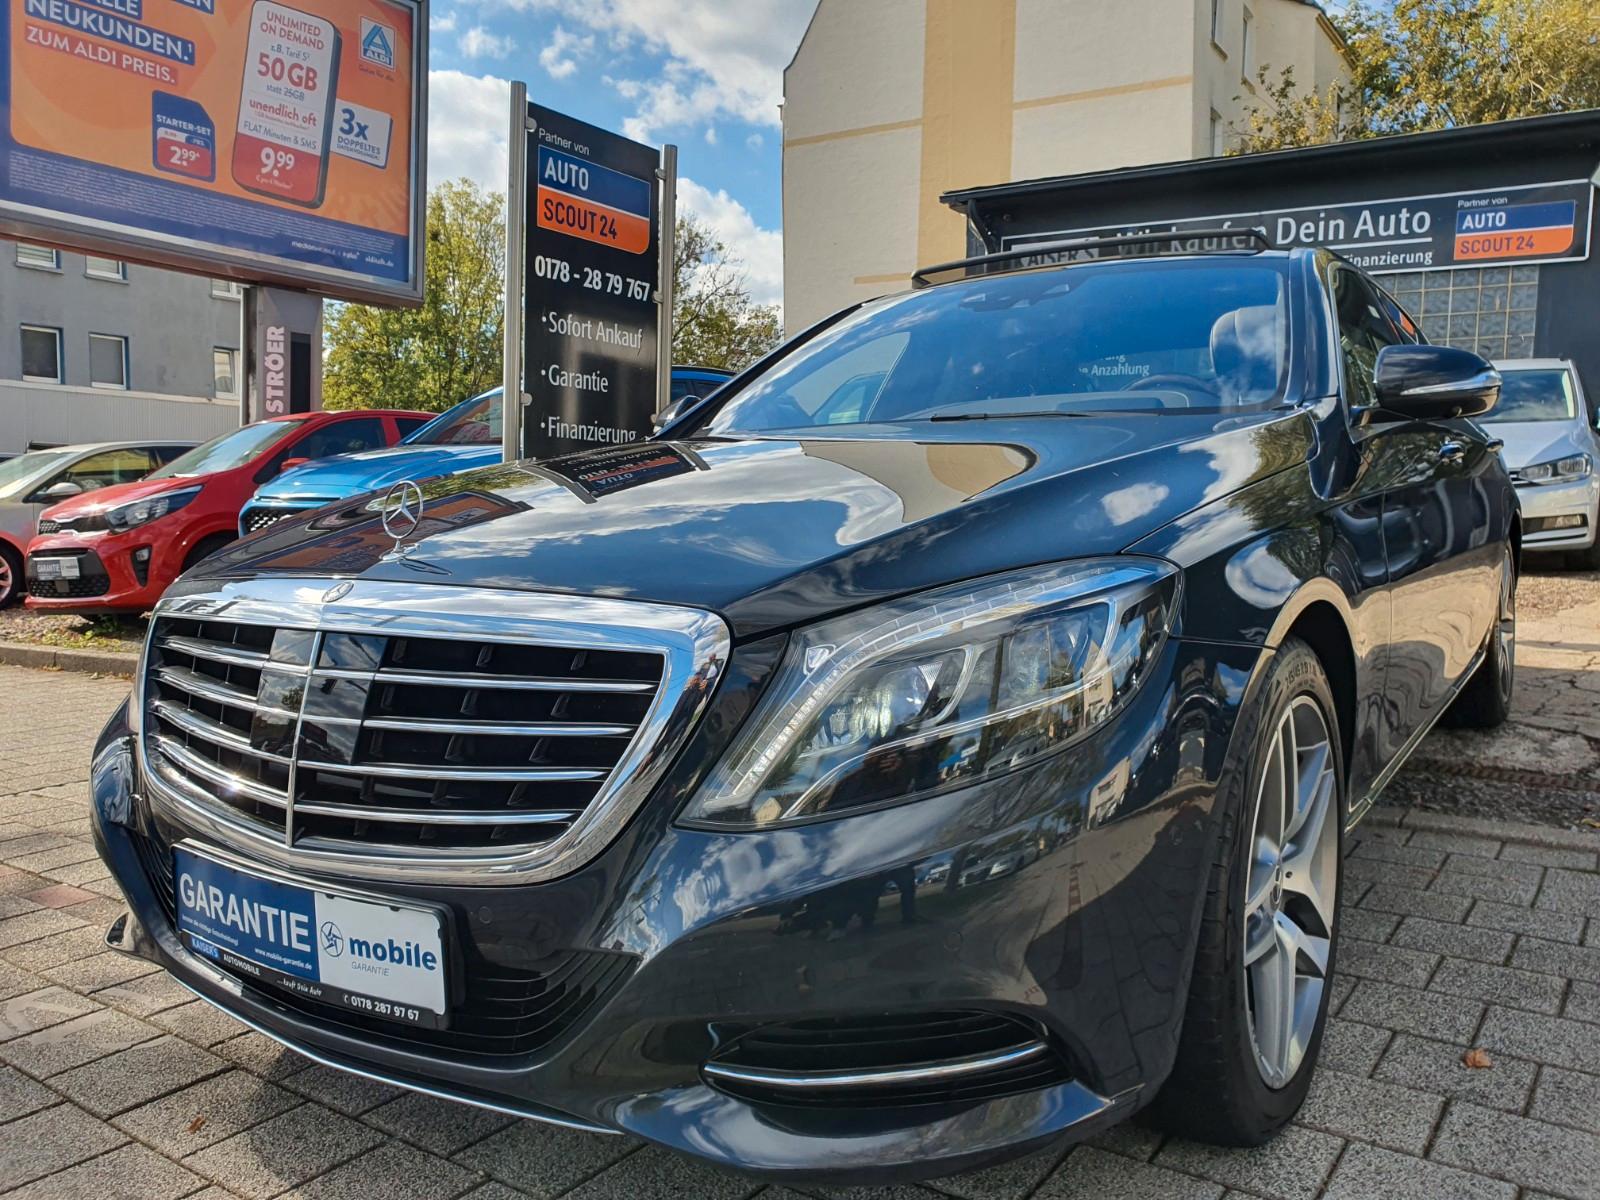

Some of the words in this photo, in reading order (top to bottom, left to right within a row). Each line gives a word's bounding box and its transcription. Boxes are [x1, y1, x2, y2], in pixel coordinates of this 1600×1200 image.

[260, 22, 277, 35] ON
[279, 27, 325, 50] DEMAND
[266, 10, 321, 36] UNLIMITED
[27, 25, 70, 52] ZUM
[74, 40, 116, 65] ALDI
[122, 54, 176, 83] PREIS.
[156, 114, 211, 136] STARTER-SET
[249, 99, 299, 121] unendlich
[302, 112, 317, 127] oft
[339, 107, 369, 141] 3x
[243, 120, 262, 133] FLAT
[300, 138, 317, 150] SMS
[337, 135, 381, 155] DOPPELTES
[538, 128, 572, 149] Partner
[574, 142, 590, 156] von
[544, 156, 589, 191] AUTO
[1457, 199, 1490, 208] Partner
[1491, 197, 1508, 206] von
[1276, 212, 1345, 245] Dein
[1353, 207, 1431, 239] Auto
[1462, 211, 1506, 230] AUTO
[1343, 251, 1433, 268] inanzierung
[534, 255, 570, 283] 0178
[583, 267, 602, 290] 28
[605, 272, 623, 296] 79
[626, 278, 650, 302] 767
[548, 311, 592, 341] Sofort
[595, 320, 643, 349] Ankauf
[264, 326, 284, 413] STRÖER
[548, 364, 609, 393] Garantie
[1091, 363, 1150, 377] Anzahlung
[548, 415, 637, 444] Finanzierung
[180, 872, 311, 953] GARANTIE
[223, 953, 260, 976] AUTOMOBILE
[349, 937, 437, 971] mobile
[351, 961, 390, 976] GARANTIE
[351, 995, 372, 1010] 0178
[374, 1001, 391, 1015] 287
[394, 1006, 406, 1018] 97
[407, 1009, 419, 1021] 67
